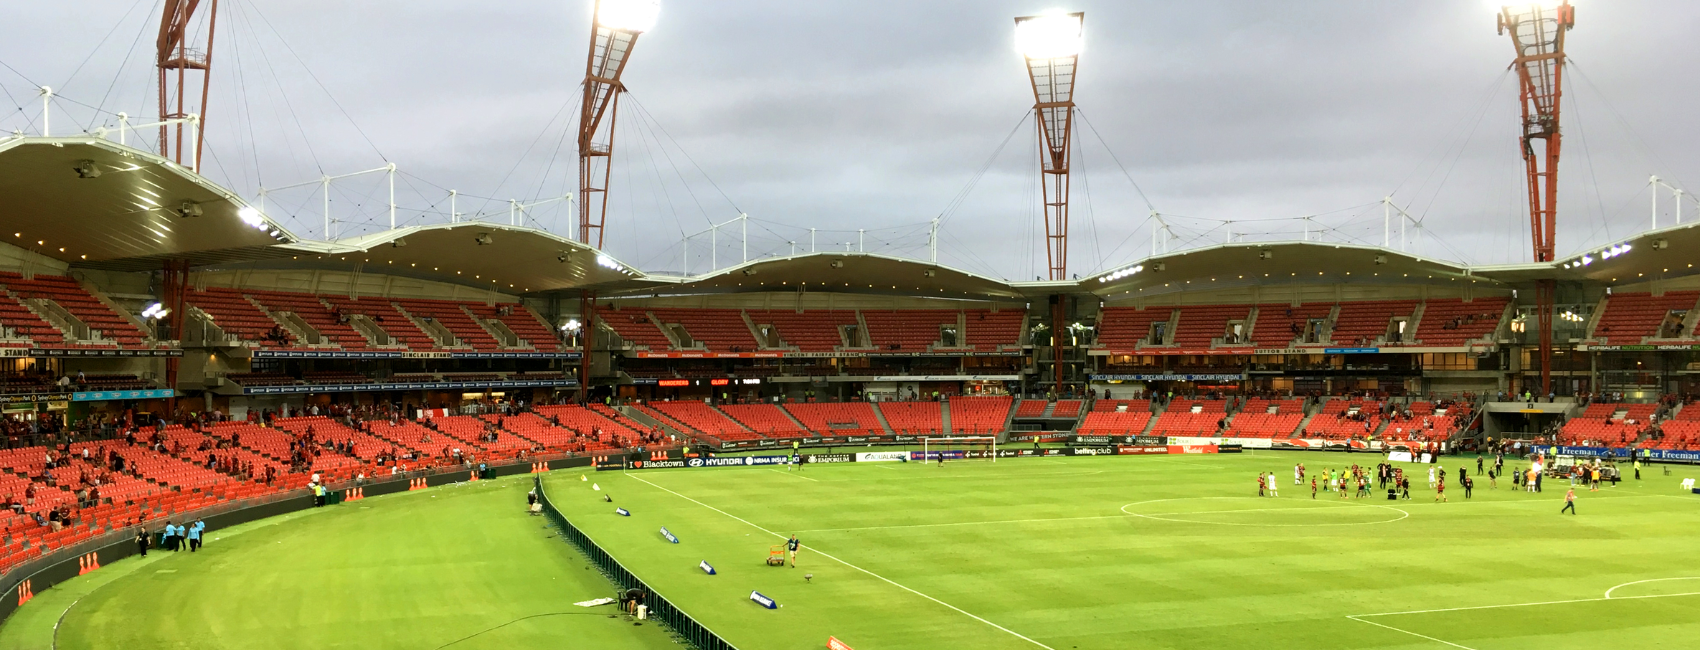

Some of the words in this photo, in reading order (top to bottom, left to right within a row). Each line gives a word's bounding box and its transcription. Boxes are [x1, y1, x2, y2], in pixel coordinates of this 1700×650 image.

[1074, 447, 1112, 456] betting.club
[1182, 445, 1204, 454] Westfield
[1662, 449, 1699, 460] Freeman
[643, 460, 684, 468] Blacktown
[706, 457, 743, 466] HYUNDAI
